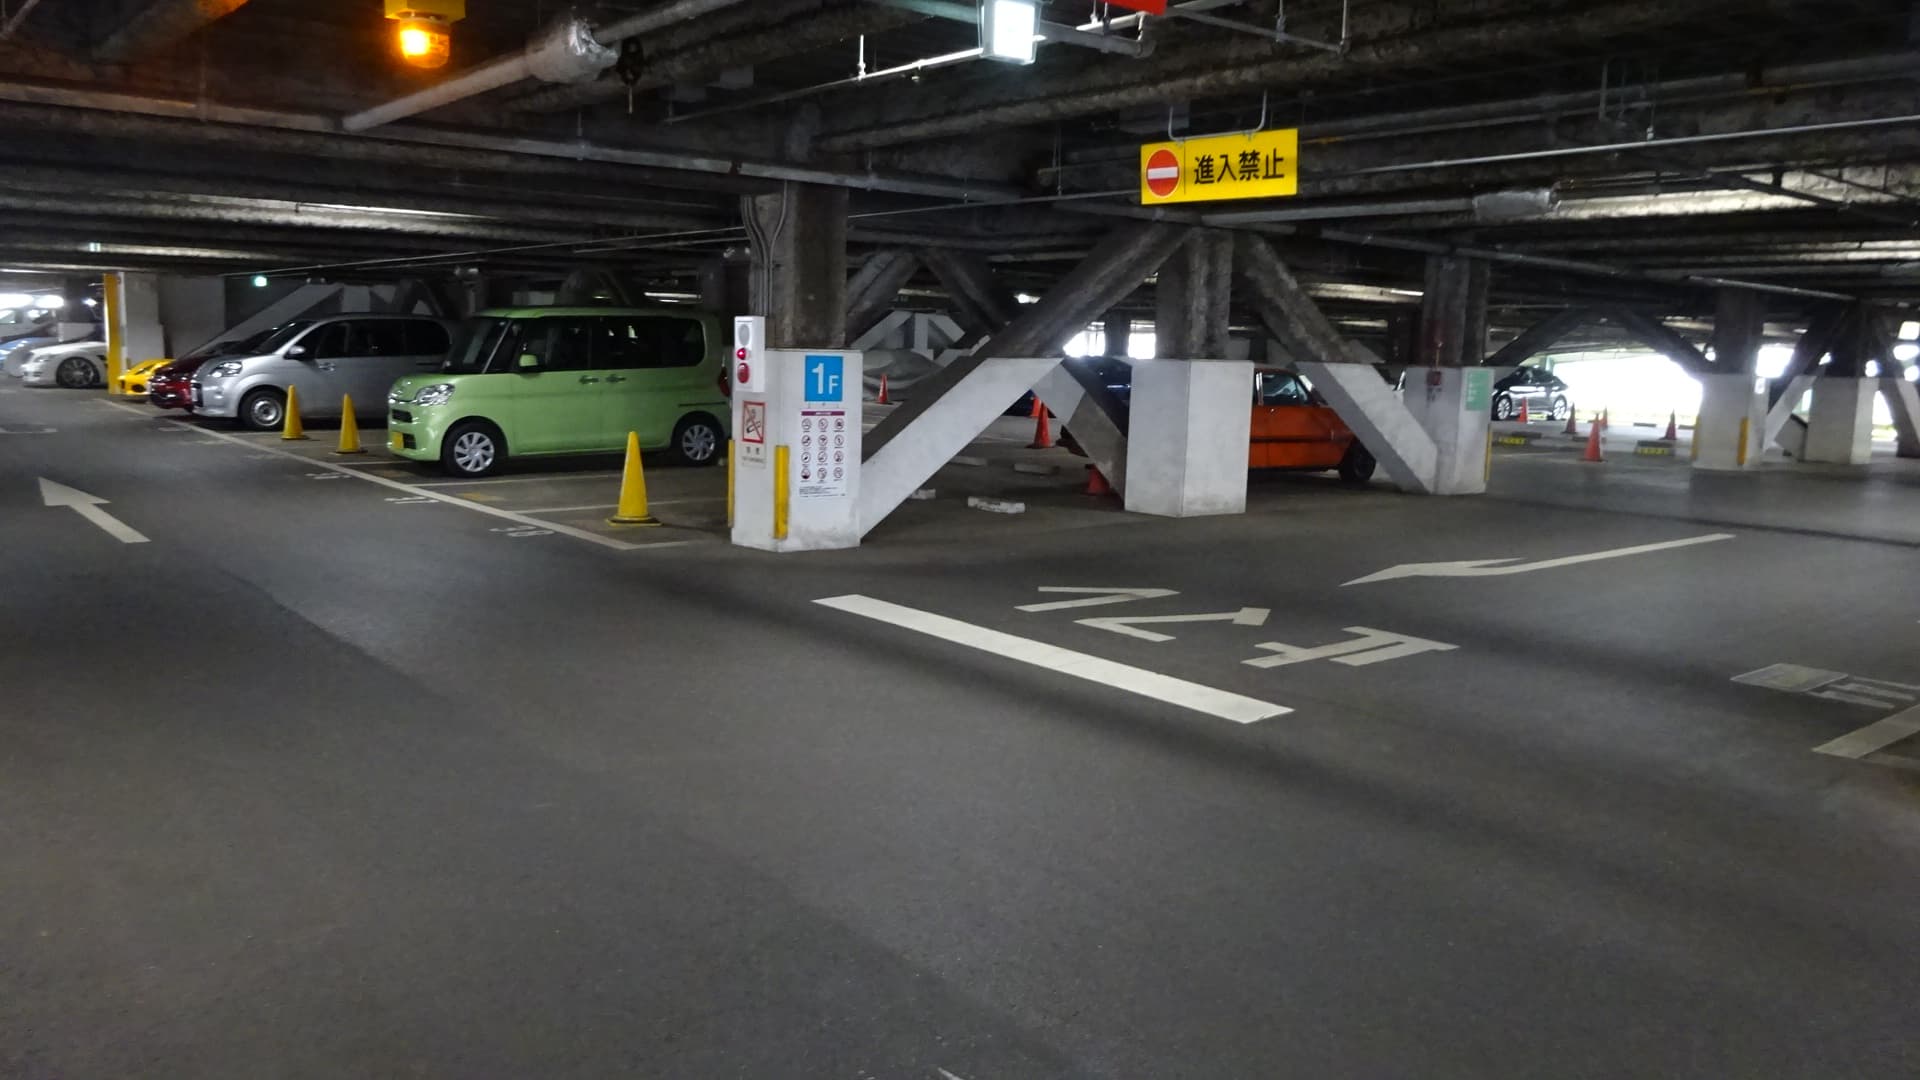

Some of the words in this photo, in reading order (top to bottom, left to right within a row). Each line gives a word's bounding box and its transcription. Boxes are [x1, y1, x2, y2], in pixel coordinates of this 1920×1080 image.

[1194, 148, 1285, 184] 進入禁止
[811, 362, 840, 395] 1F
